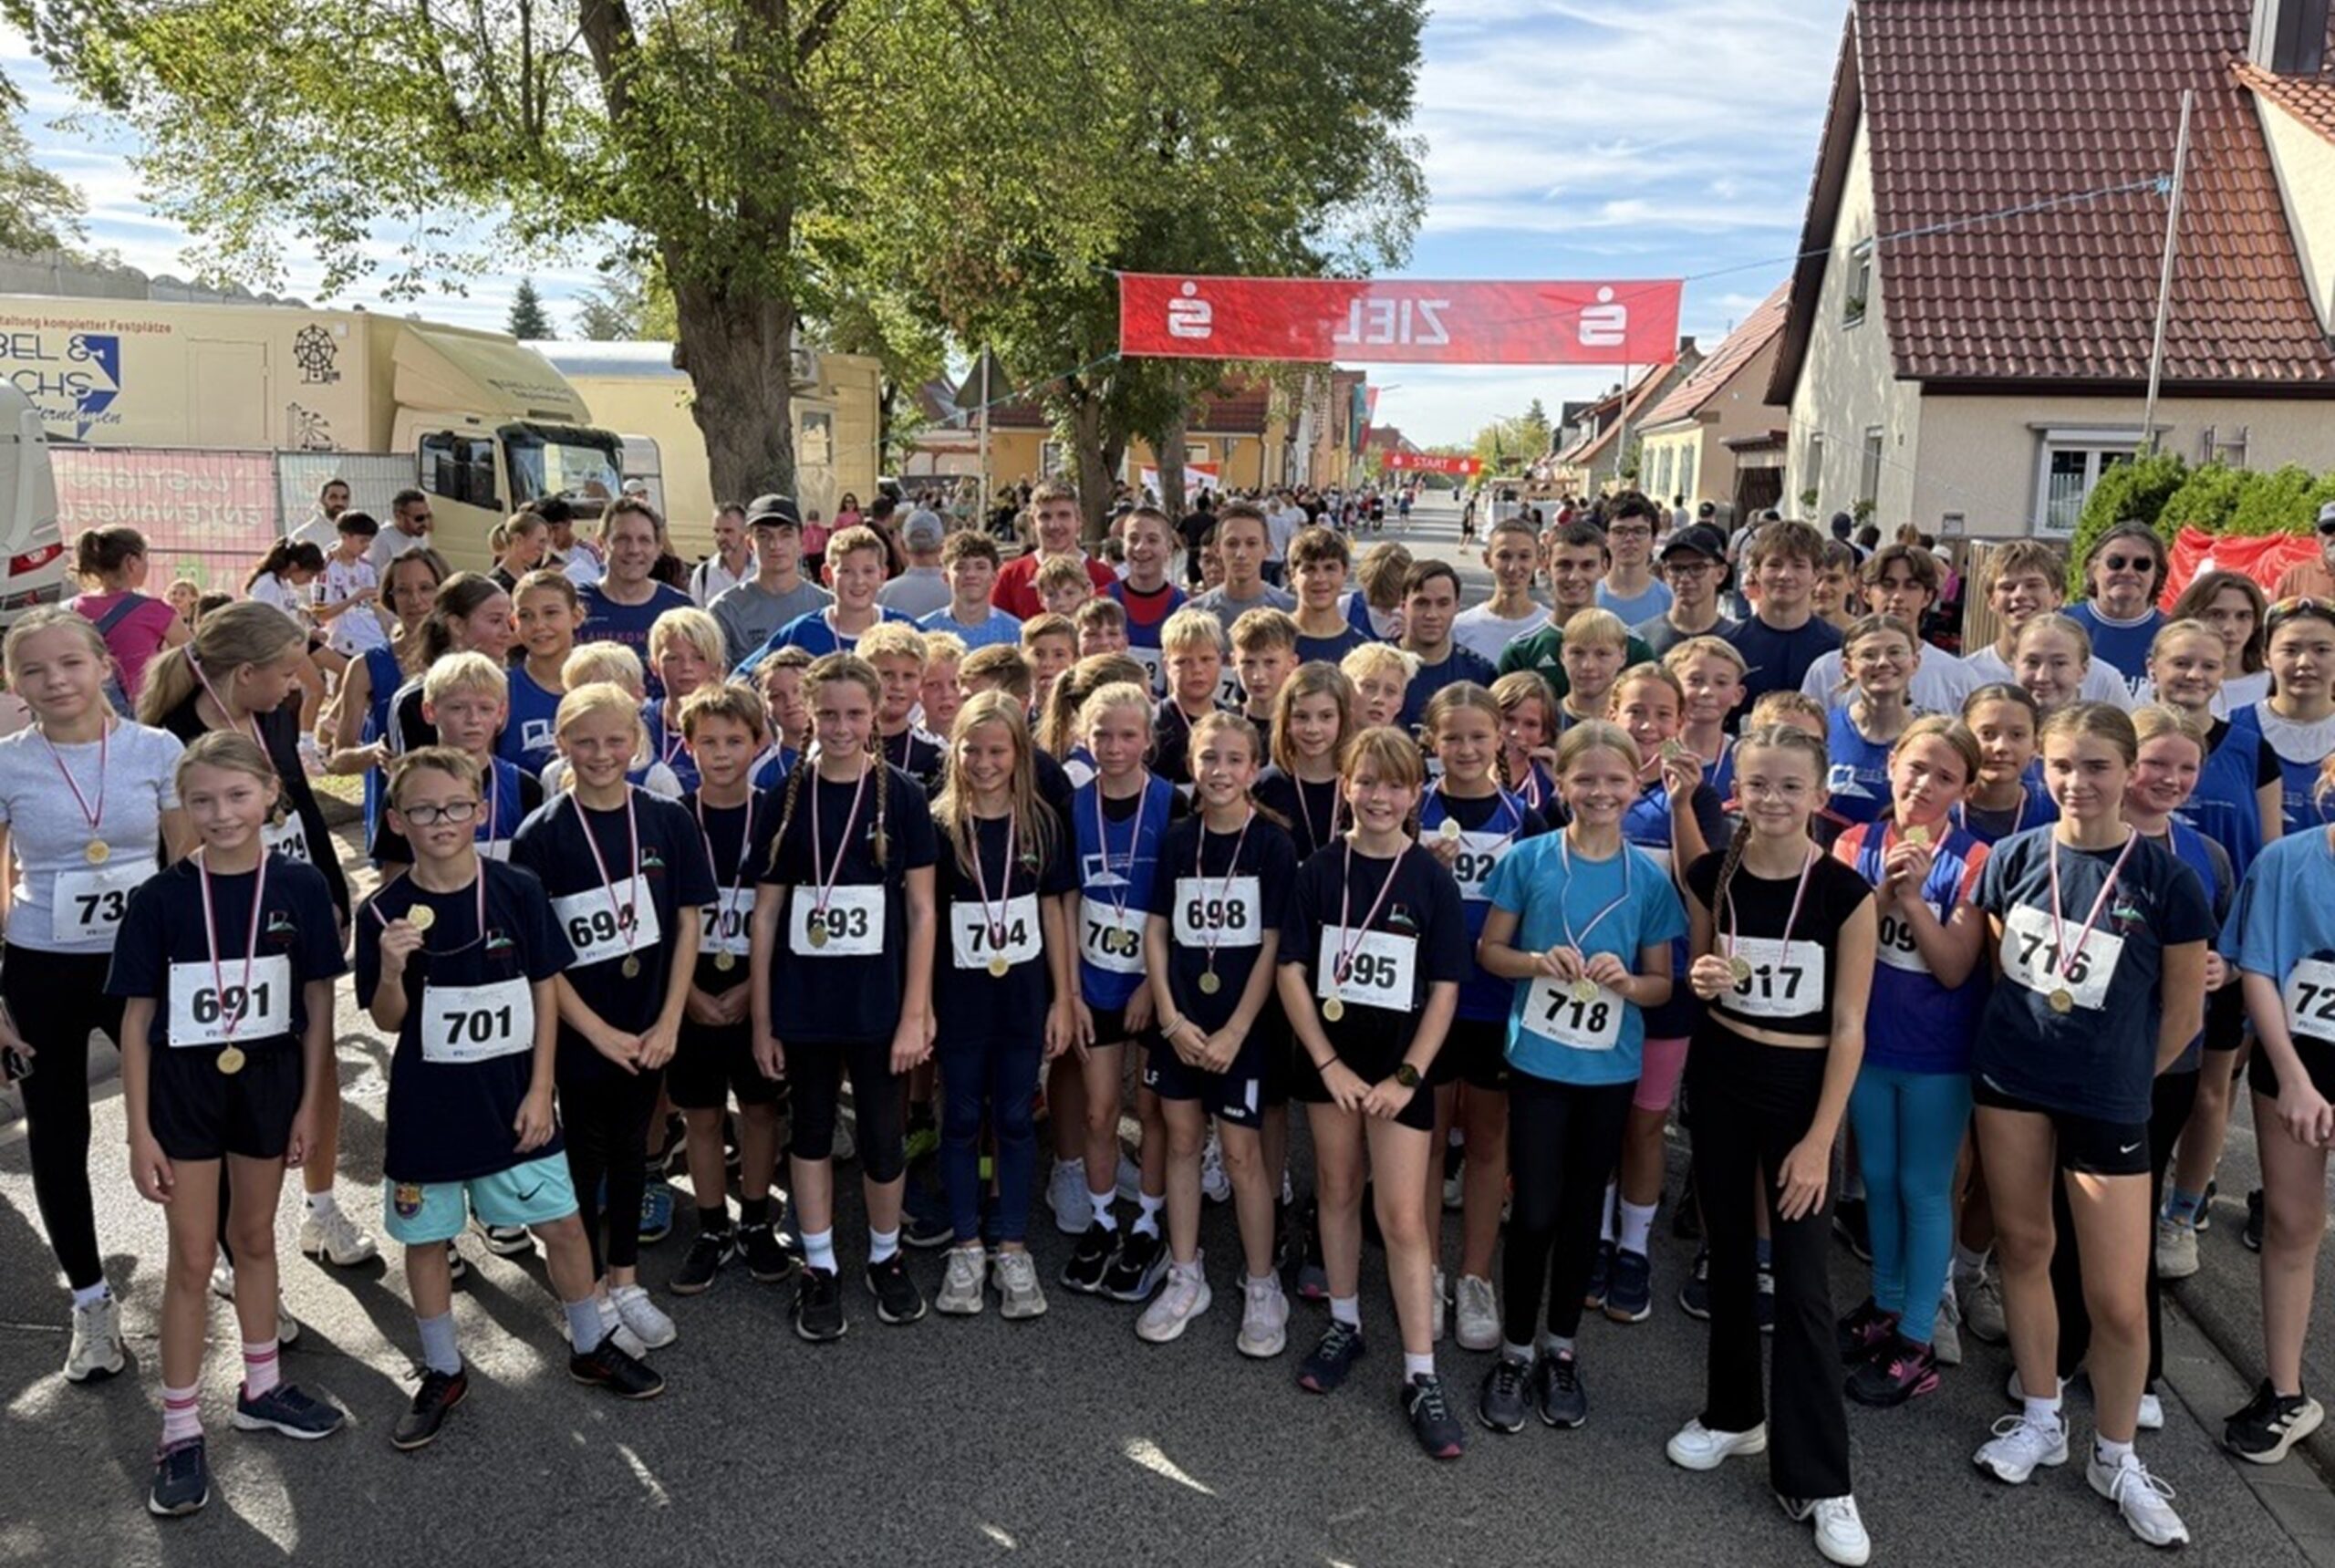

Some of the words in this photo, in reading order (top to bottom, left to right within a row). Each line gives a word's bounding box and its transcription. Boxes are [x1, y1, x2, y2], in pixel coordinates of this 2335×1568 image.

[44, 317, 107, 331] kompletter
[109, 319, 171, 335] Festplätze
[0, 369, 92, 399] CHS
[1413, 457, 1448, 469] START
[1455, 853, 1495, 883] 92
[569, 903, 638, 948] 694
[807, 908, 868, 939] 693
[1188, 898, 1246, 930] 698
[968, 919, 1027, 952] 704
[1088, 920, 1140, 959] 708
[1880, 915, 1916, 952] 09
[1334, 951, 1396, 990] 695
[2018, 931, 2091, 984] 716
[192, 981, 269, 1024] 691
[1545, 988, 1609, 1033] 718
[443, 1004, 511, 1044] 701
